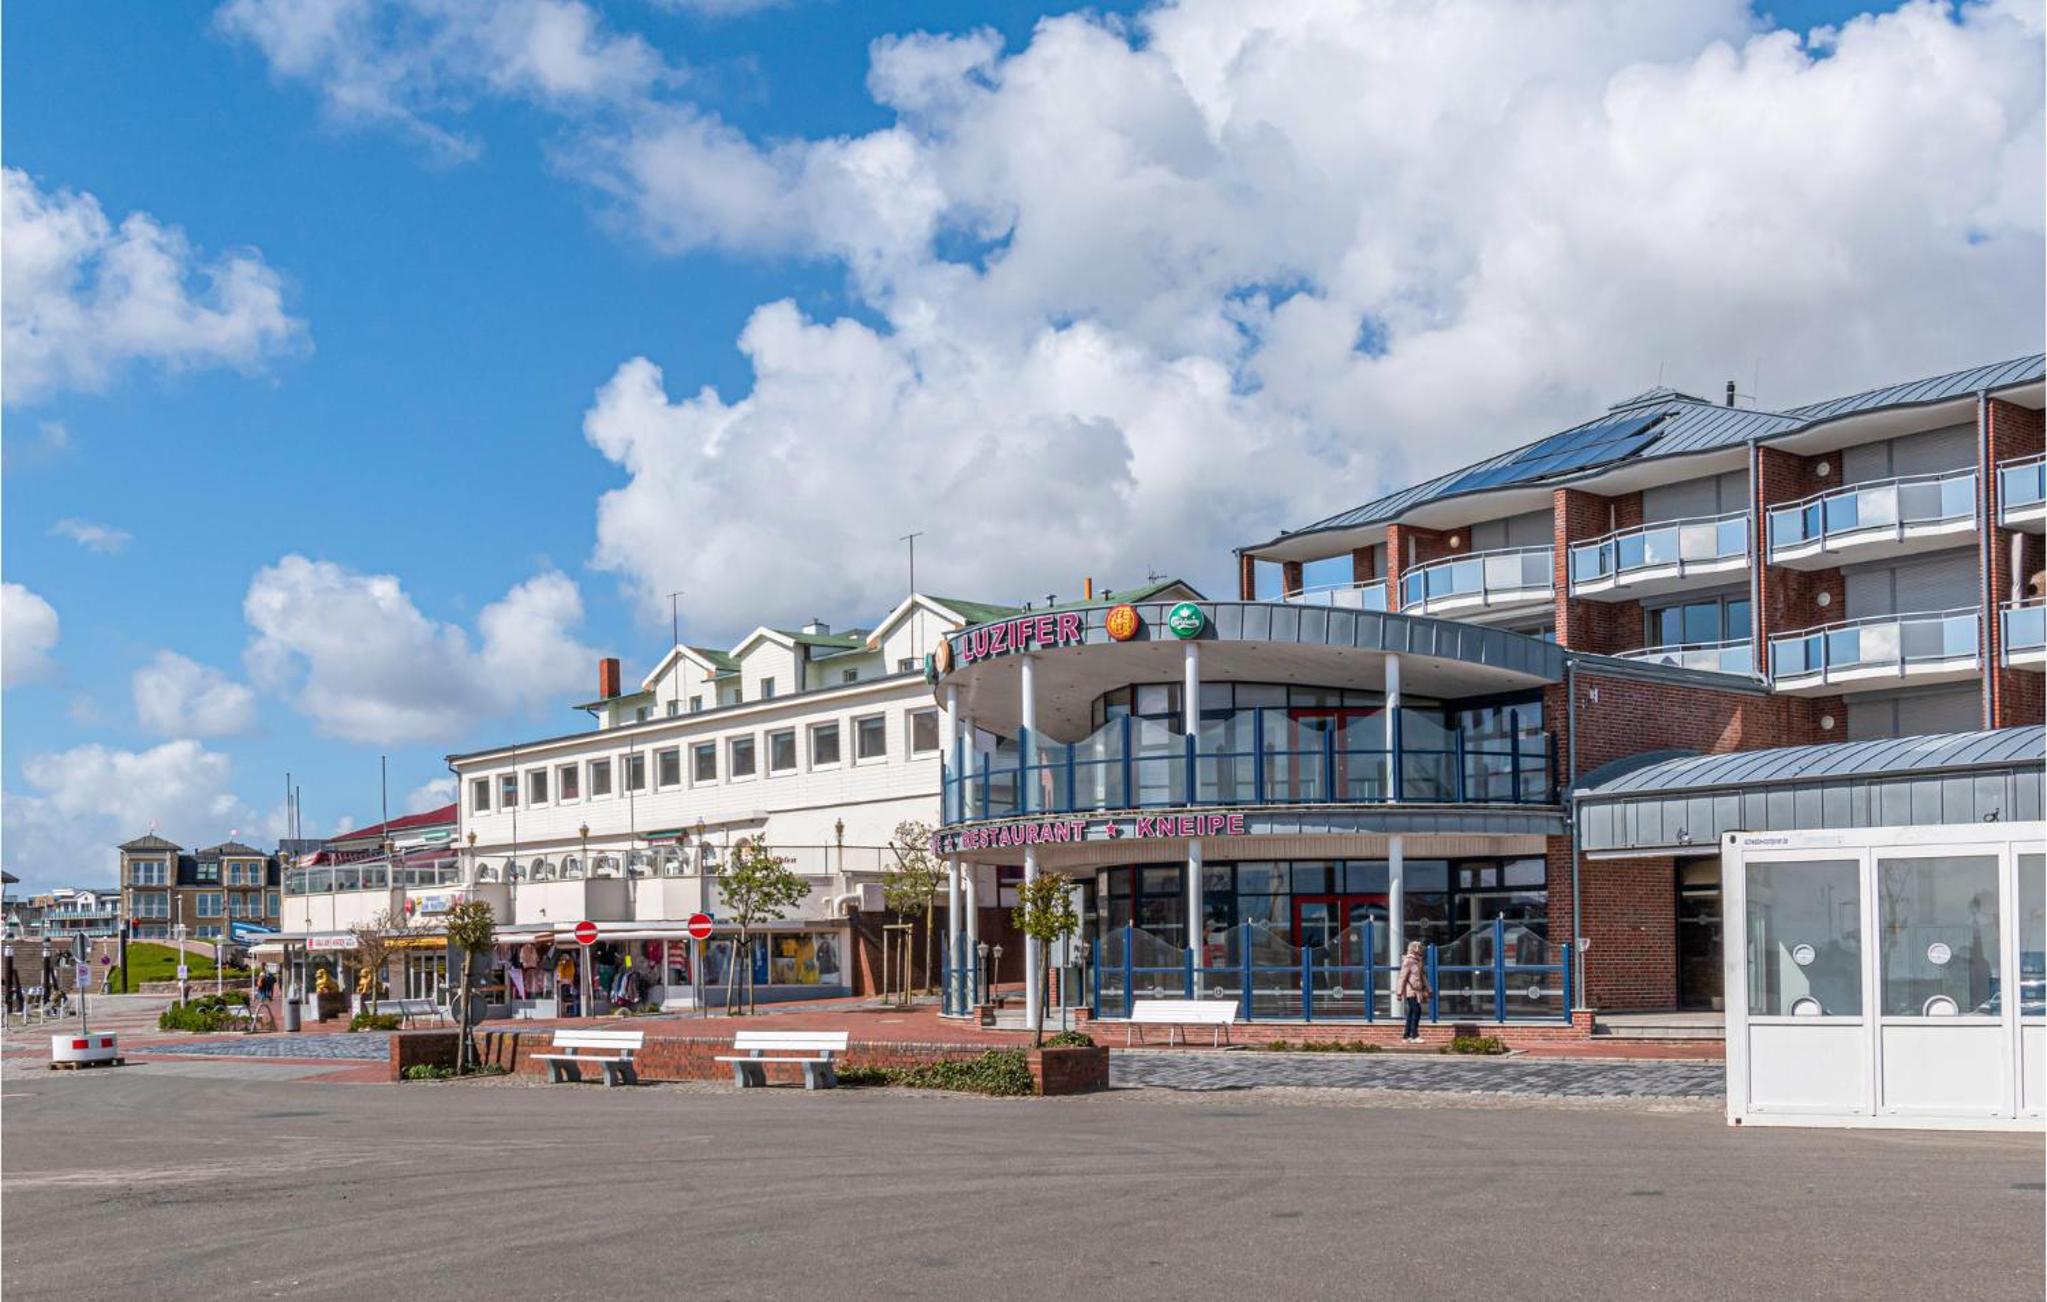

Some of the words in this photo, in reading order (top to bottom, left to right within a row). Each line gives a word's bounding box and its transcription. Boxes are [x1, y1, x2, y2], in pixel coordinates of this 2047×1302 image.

[962, 612, 1080, 661] LUZIFER
[961, 820, 1086, 849] RESTAURANT
[1136, 814, 1245, 838] KNEIPE
